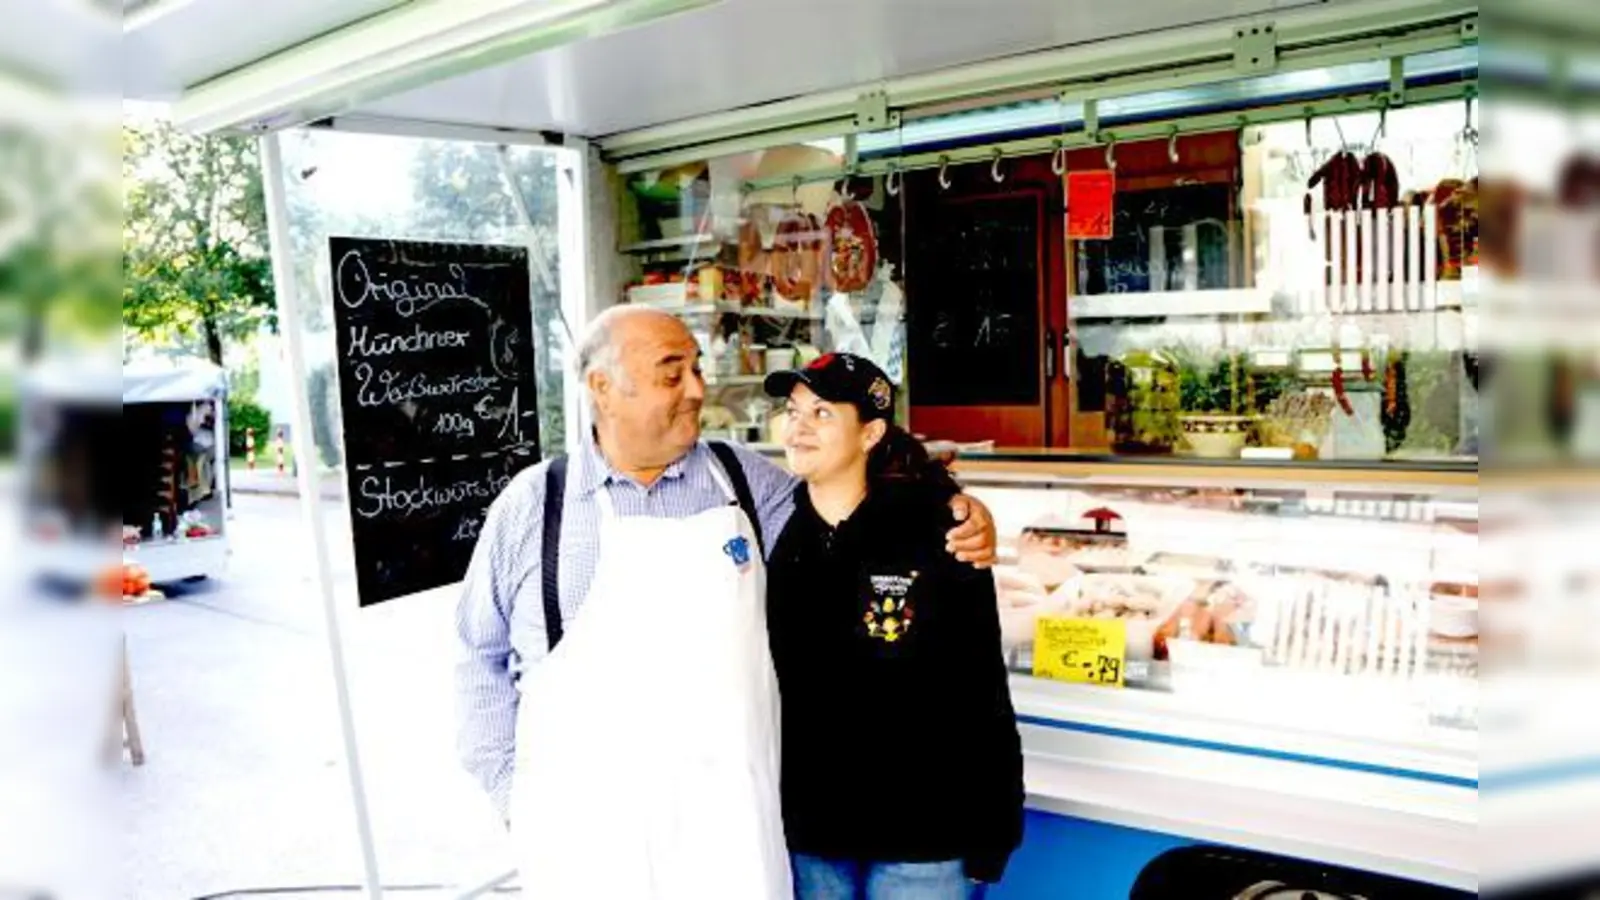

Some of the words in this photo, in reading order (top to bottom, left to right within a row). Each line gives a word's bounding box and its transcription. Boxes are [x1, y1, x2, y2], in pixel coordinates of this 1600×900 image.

[337, 250, 468, 317] Original
[348, 324, 470, 356] Münchner
[432, 412, 475, 438] 100g
[473, 394, 495, 420] €
[1061, 650, 1080, 668] €
